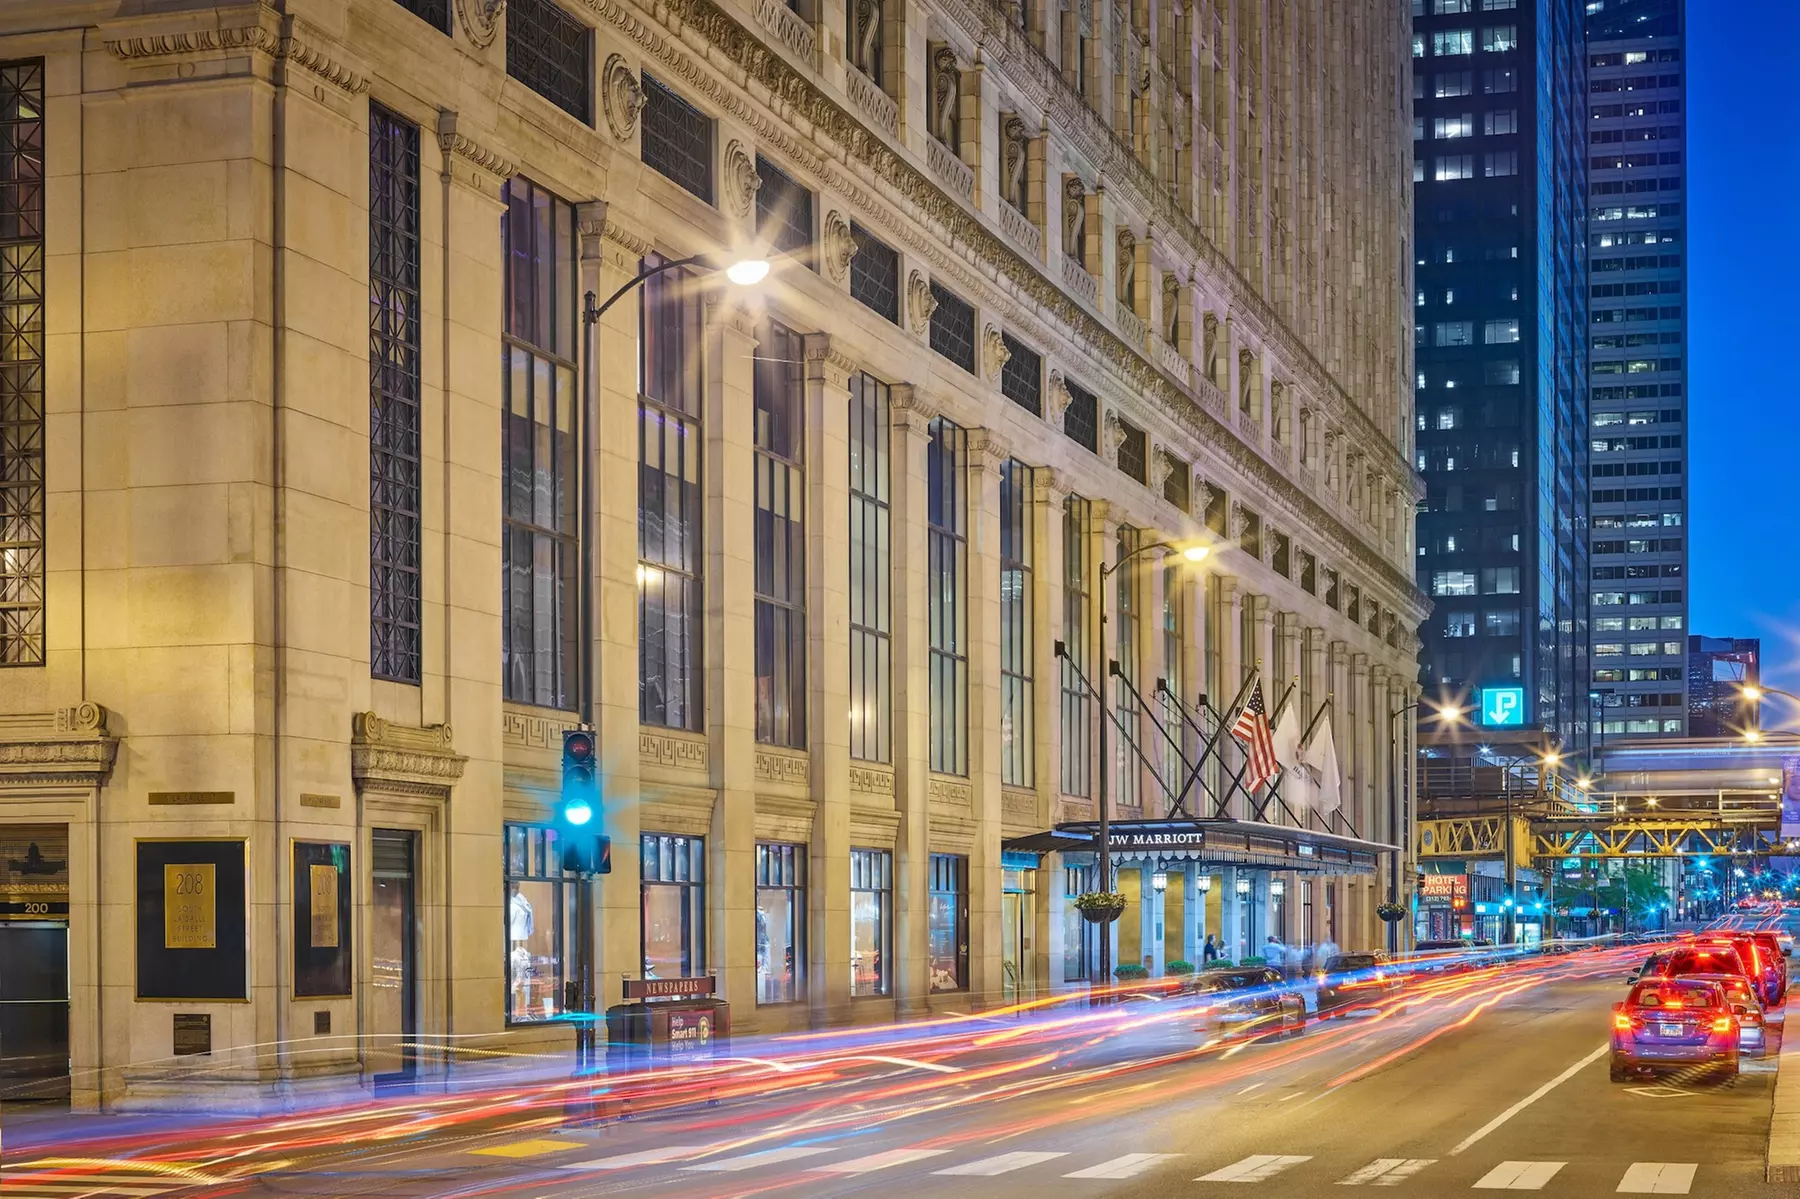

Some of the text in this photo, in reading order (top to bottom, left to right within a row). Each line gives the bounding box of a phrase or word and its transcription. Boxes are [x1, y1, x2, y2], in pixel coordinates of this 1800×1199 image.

[1109, 833, 1203, 845] JW MARRIOTT
[176, 873, 203, 895] 208
[1428, 875, 1461, 885] HOTEL
[1423, 886, 1466, 895] PARKING
[25, 903, 48, 914] 200
[178, 905, 202, 913] SOUTH
[177, 925, 202, 933] STREET
[173, 935, 208, 943] BUILDING
[646, 981, 699, 994] NEWSPAPERS
[671, 1016, 684, 1029] Help
[671, 1027, 697, 1039] Smart 911
[671, 1040, 684, 1052] Help
